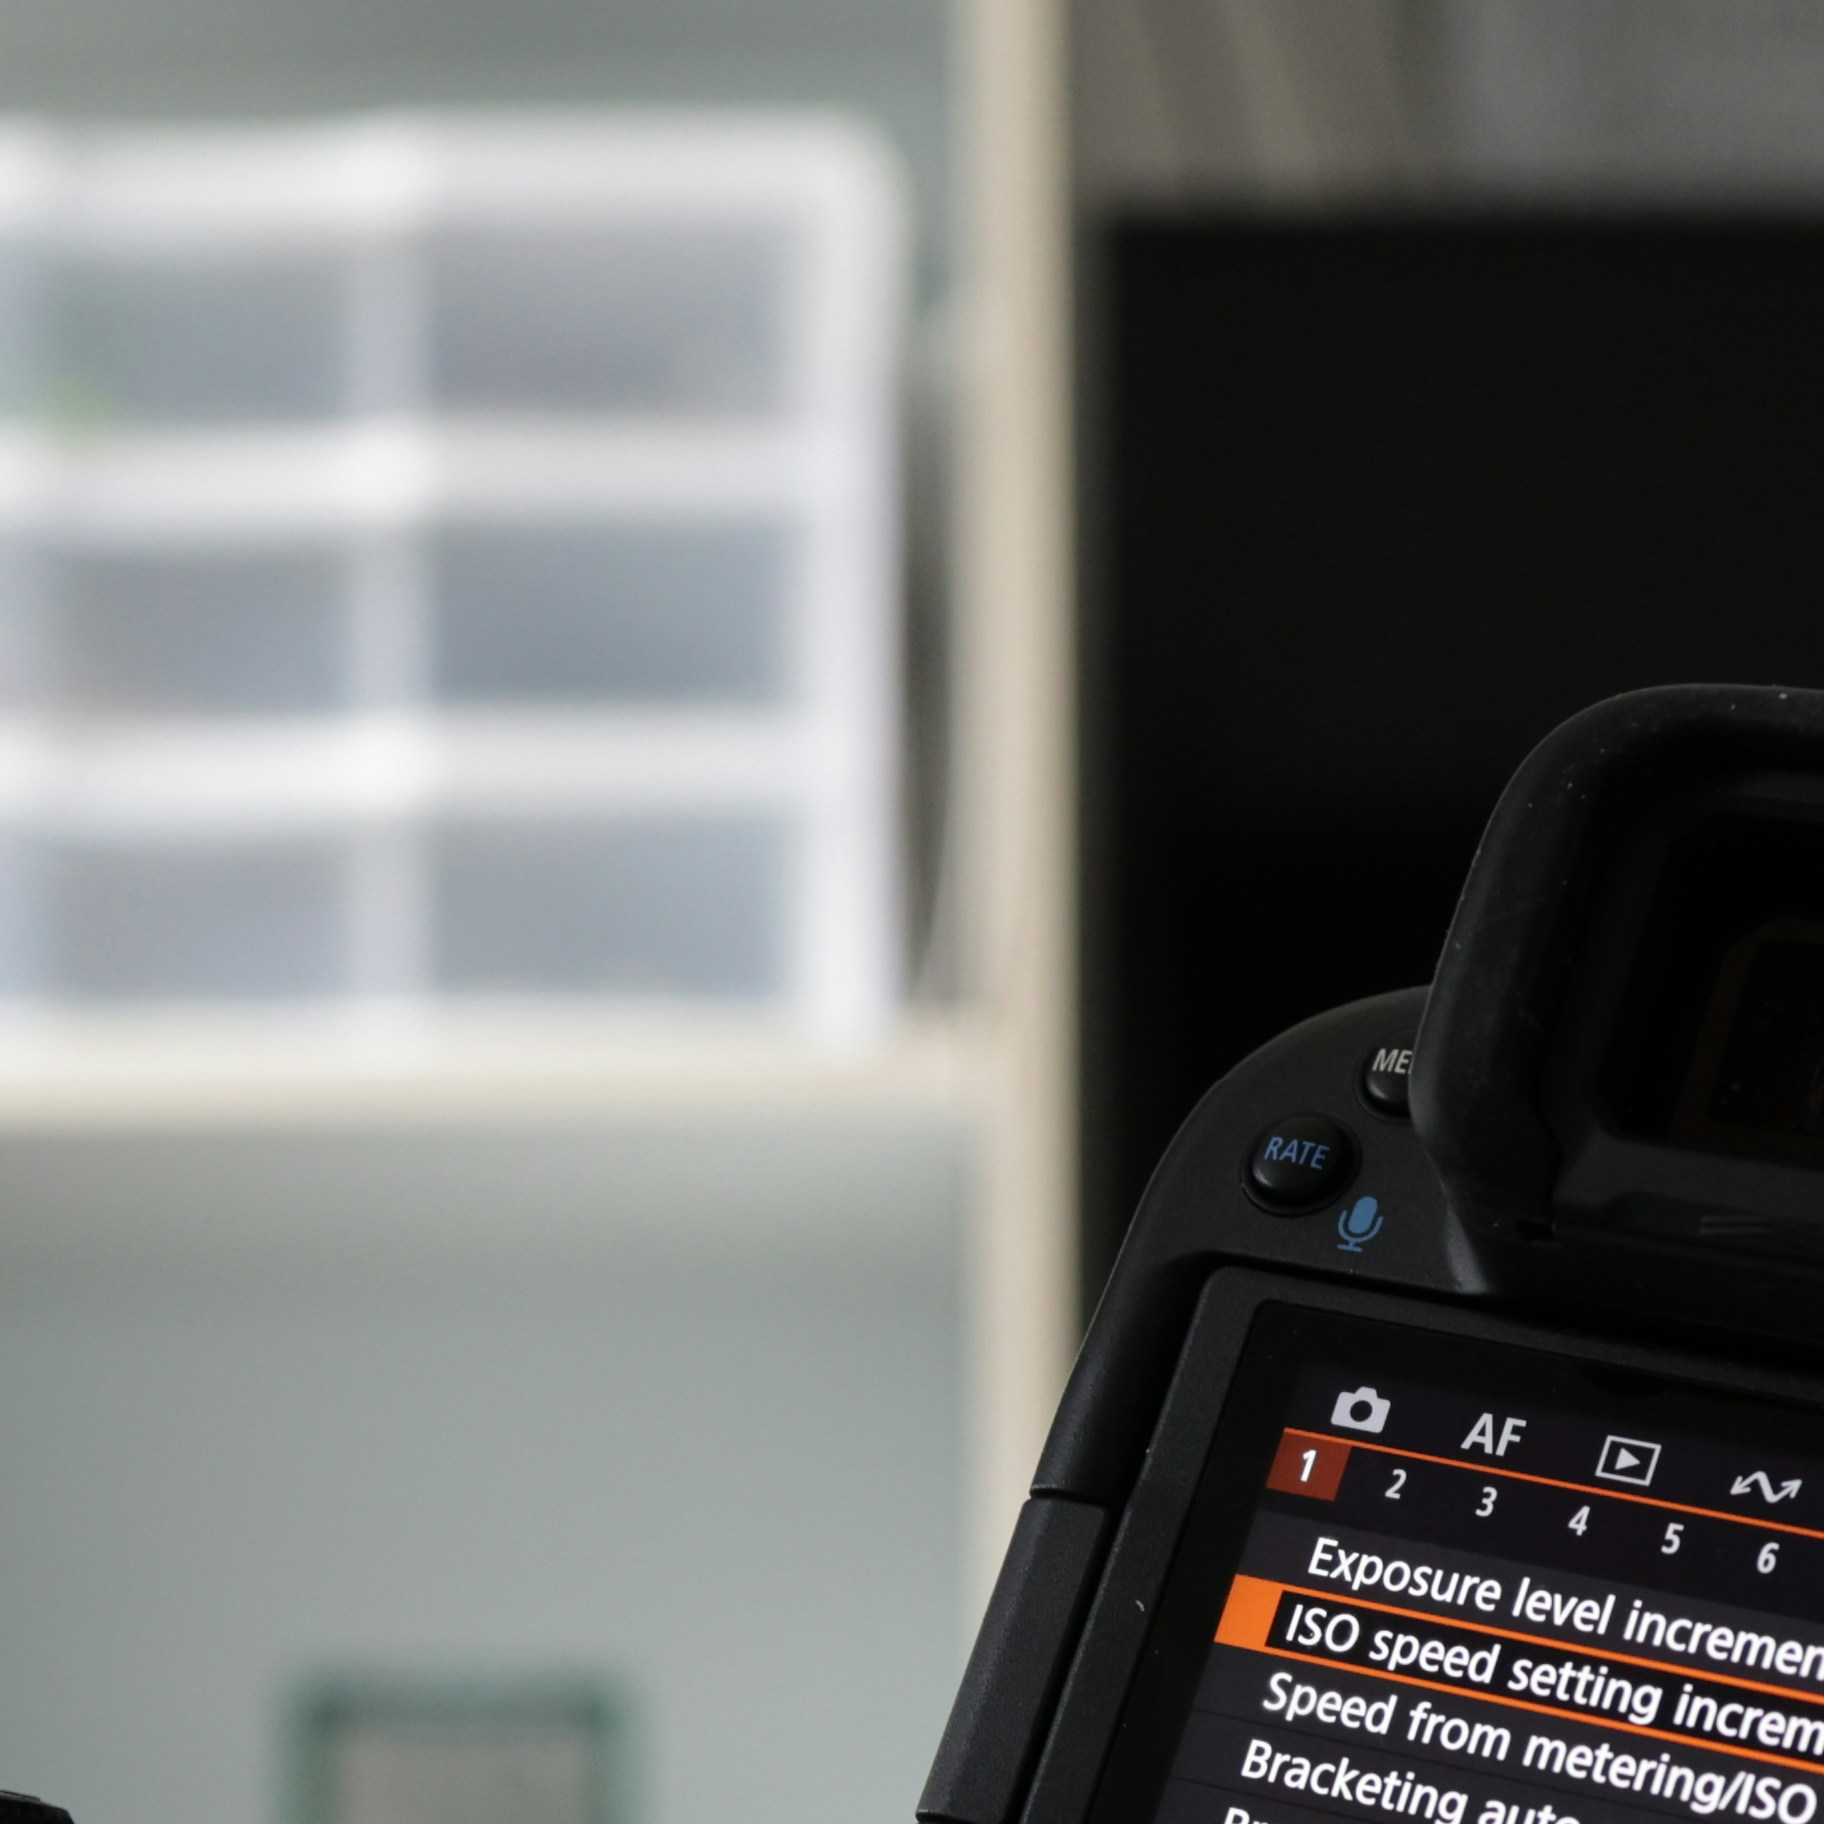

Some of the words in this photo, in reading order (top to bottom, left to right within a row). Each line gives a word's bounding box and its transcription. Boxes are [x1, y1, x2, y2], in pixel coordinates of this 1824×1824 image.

[1372, 1048, 1414, 1075] ME
[1264, 1136, 1330, 1170] RATE
[1461, 1412, 1526, 1457] AF
[1300, 1449, 1317, 1482] 1
[1385, 1469, 1407, 1500] 2
[1476, 1487, 1498, 1518] 3
[1568, 1505, 1590, 1537] 4
[1661, 1522, 1685, 1555] 5
[1757, 1542, 1779, 1575] 6
[1307, 1537, 1502, 1613] Exposure
[1513, 1576, 1615, 1635] level
[1285, 1603, 1360, 1653] ISO
[1369, 1626, 1501, 1685] speed
[1507, 1658, 1663, 1726] setting
[1262, 1672, 1398, 1735] Speed
[1406, 1701, 1512, 1761] from
